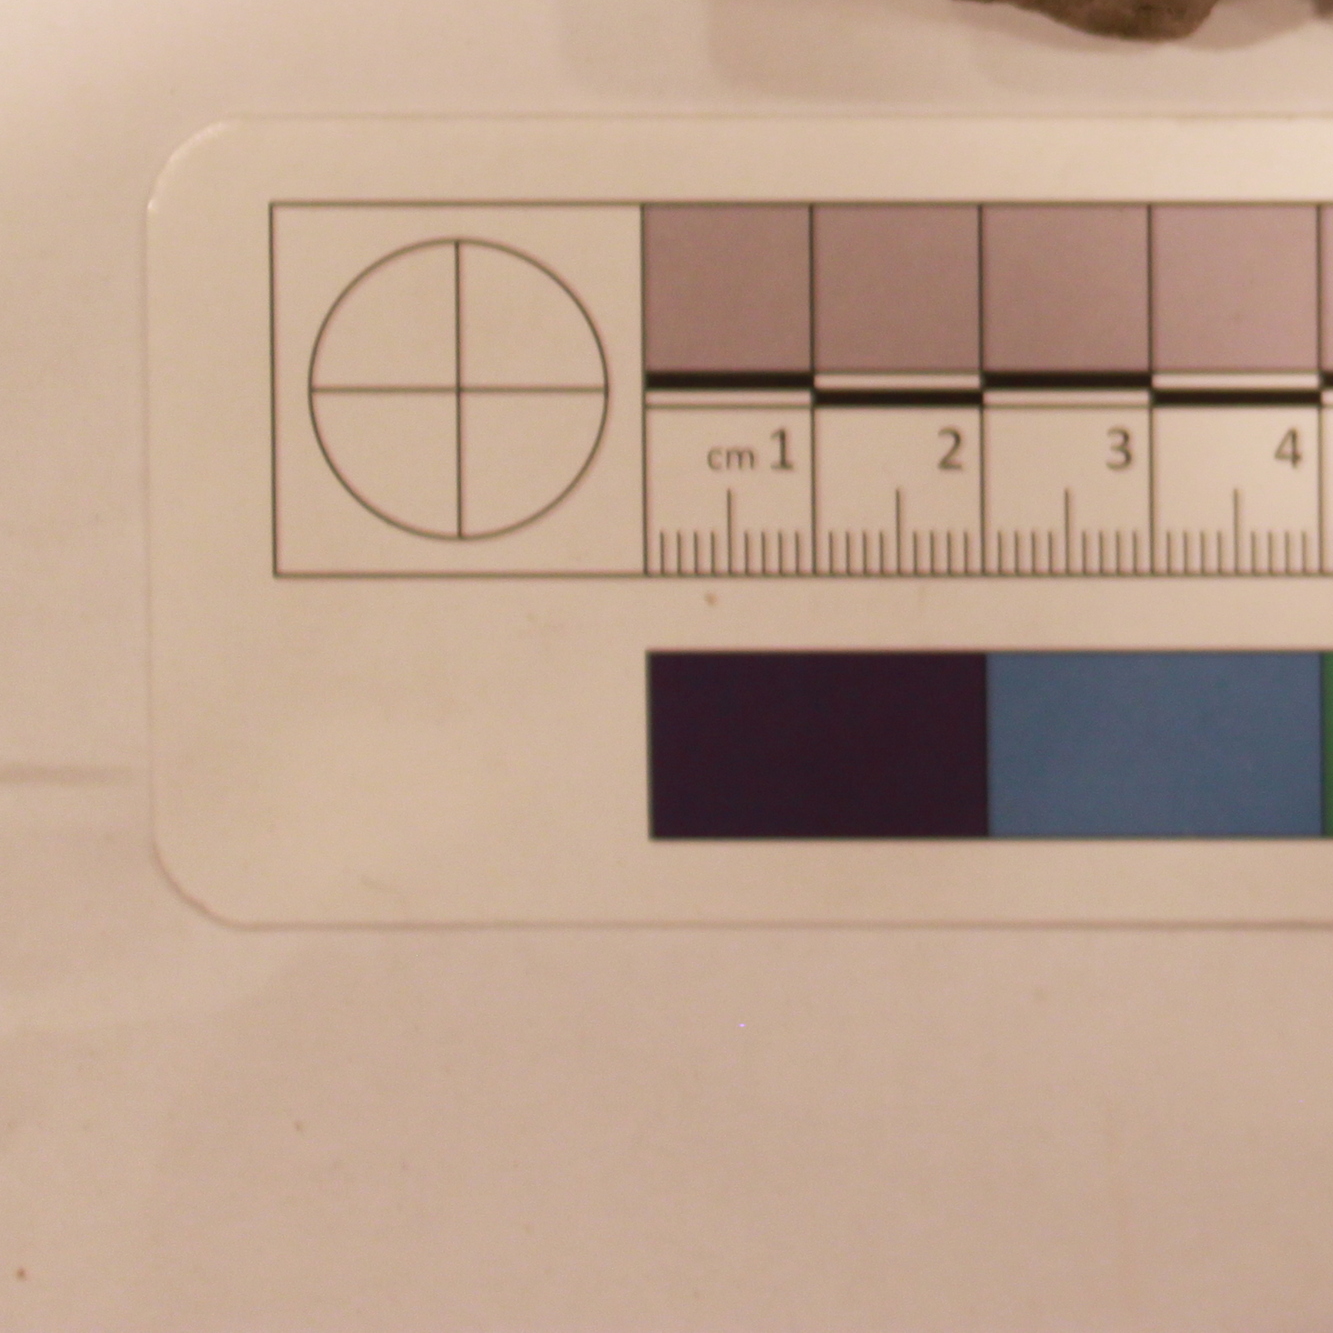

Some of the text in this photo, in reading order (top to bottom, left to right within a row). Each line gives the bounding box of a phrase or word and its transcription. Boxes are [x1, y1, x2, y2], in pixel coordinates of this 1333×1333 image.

[706, 448, 756, 471] cm
[771, 427, 795, 472] 1
[937, 426, 964, 472] 2
[1107, 427, 1134, 472] 3
[1273, 427, 1304, 469] 4
